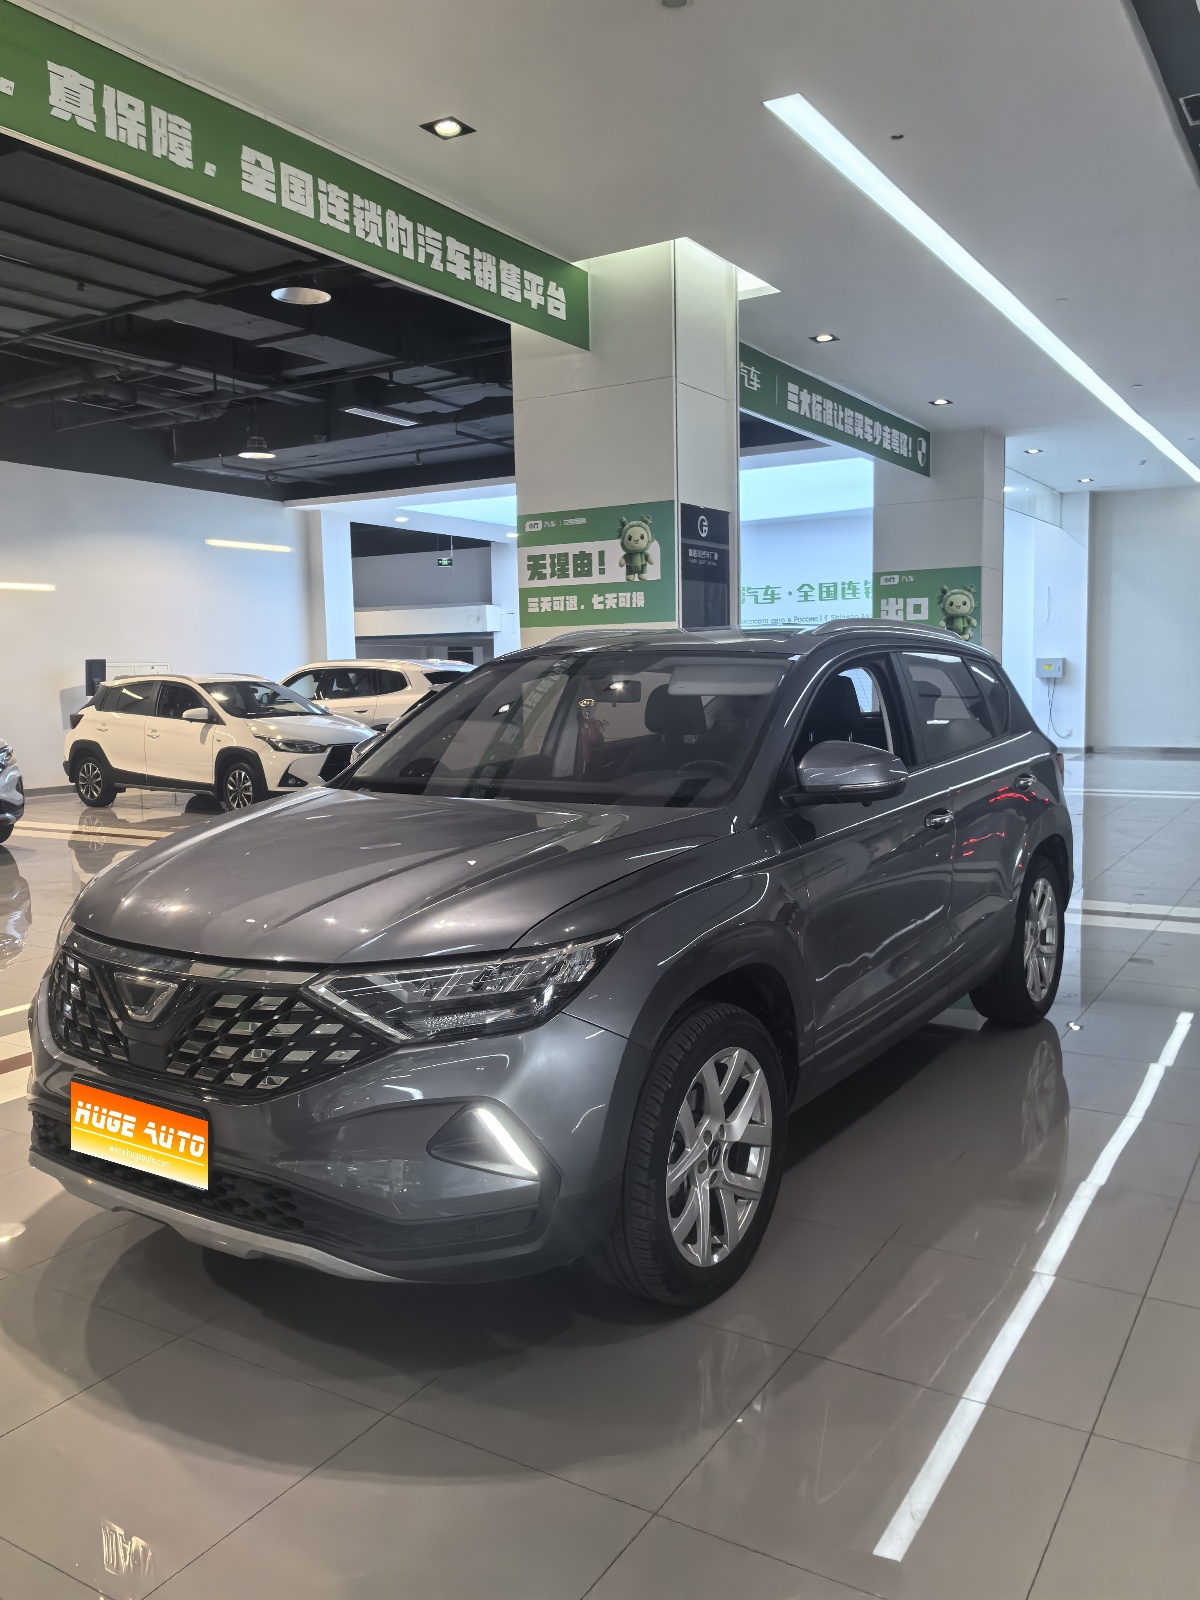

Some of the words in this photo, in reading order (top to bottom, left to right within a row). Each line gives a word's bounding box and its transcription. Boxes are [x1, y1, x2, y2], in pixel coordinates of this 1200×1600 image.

[526, 550, 606, 581] 无理由！
[881, 597, 929, 621] 出口
